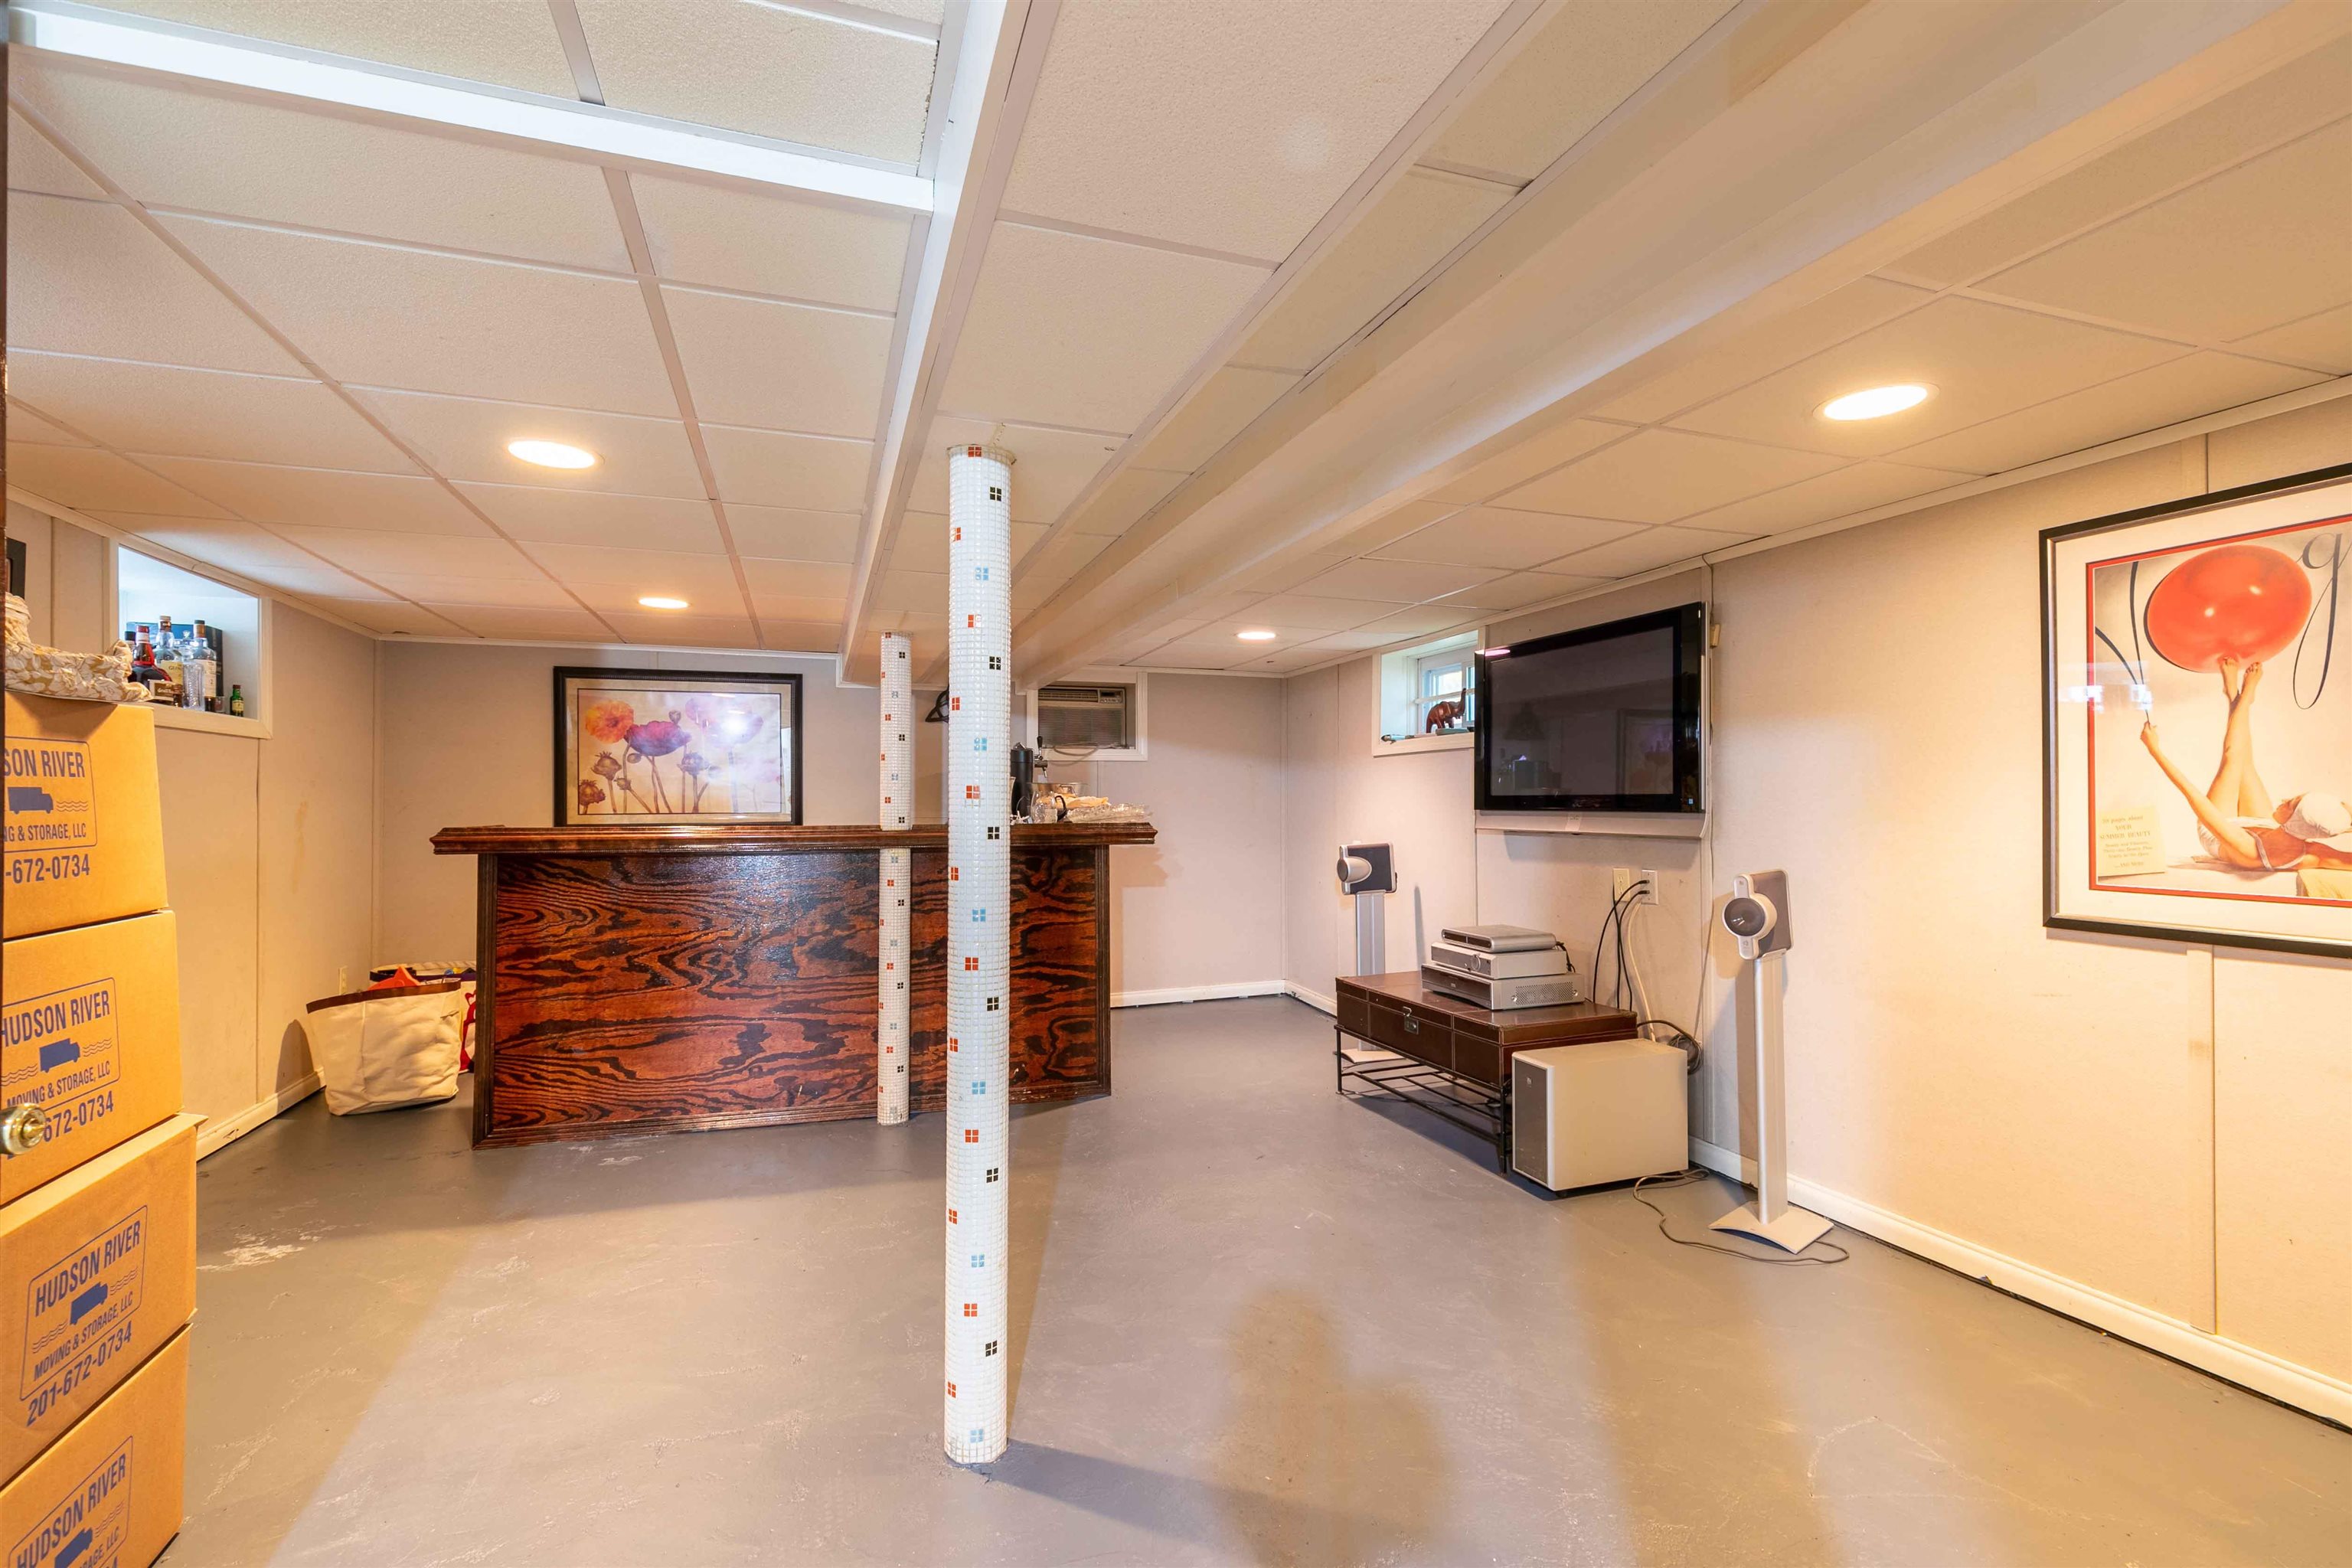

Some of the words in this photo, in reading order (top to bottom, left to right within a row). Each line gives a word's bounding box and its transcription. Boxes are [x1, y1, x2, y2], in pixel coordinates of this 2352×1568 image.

[41, 750, 86, 778] RIVER
[18, 825, 25, 841] &
[28, 823, 71, 841] STORAGE,
[73, 822, 87, 838] LLC
[2, 1001, 67, 1047] HUDSON
[70, 990, 110, 1027] RIVER
[47, 1083, 54, 1098] &
[57, 1067, 96, 1096] STORAGE,
[98, 1060, 110, 1080] LLC
[35, 1246, 100, 1317] HUDSON
[104, 1220, 141, 1269] RIVER
[27, 1320, 132, 1426] 201-672-0734
[34, 1339, 71, 1381] MOVING
[72, 1333, 79, 1351] &
[81, 1304, 118, 1344] STORAGE,
[120, 1292, 133, 1312] LLC
[17, 1494, 84, 1568] HUDSON
[88, 1453, 126, 1514] RIVER
